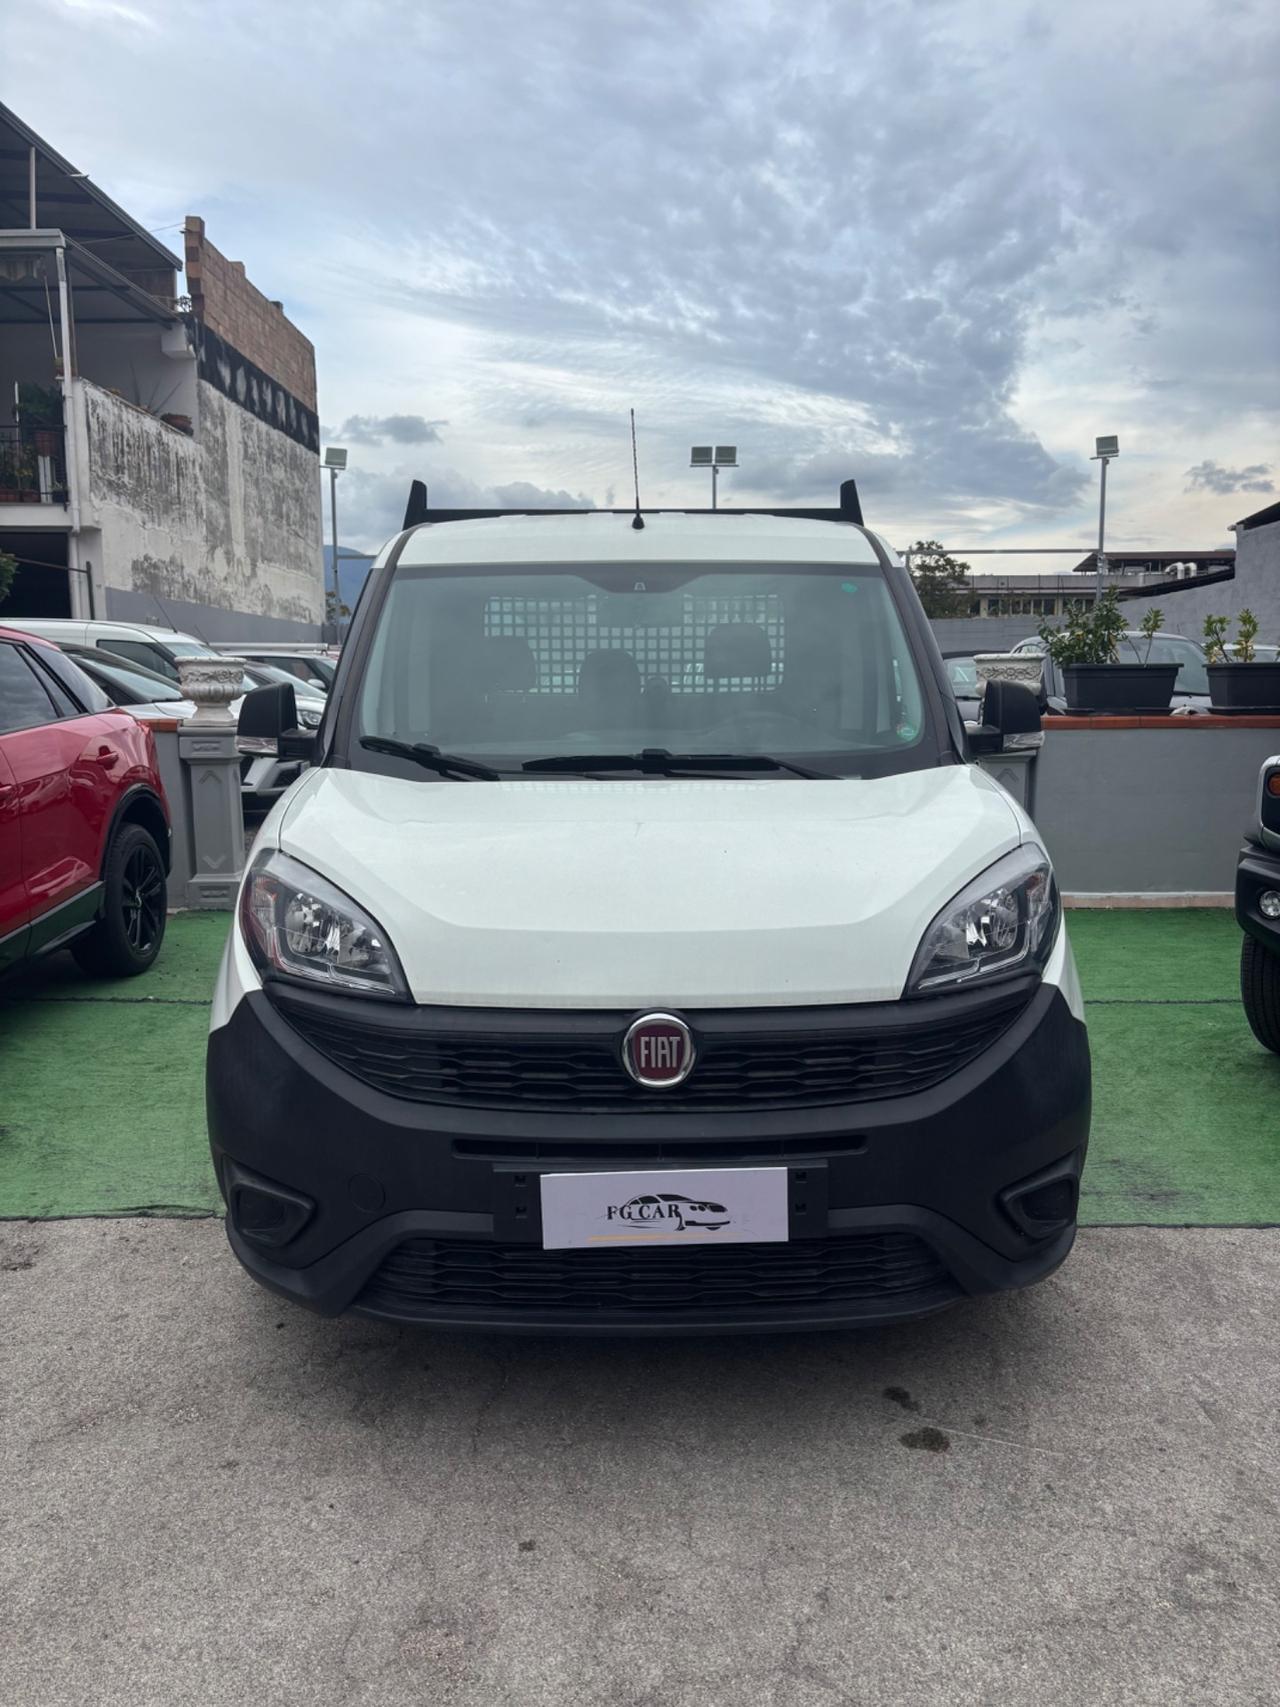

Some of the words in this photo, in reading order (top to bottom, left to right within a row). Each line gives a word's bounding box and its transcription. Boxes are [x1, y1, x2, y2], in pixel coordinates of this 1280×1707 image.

[640, 1036, 681, 1068] FIAT
[607, 1205, 633, 1220] FG
[638, 1203, 684, 1224] CAR
